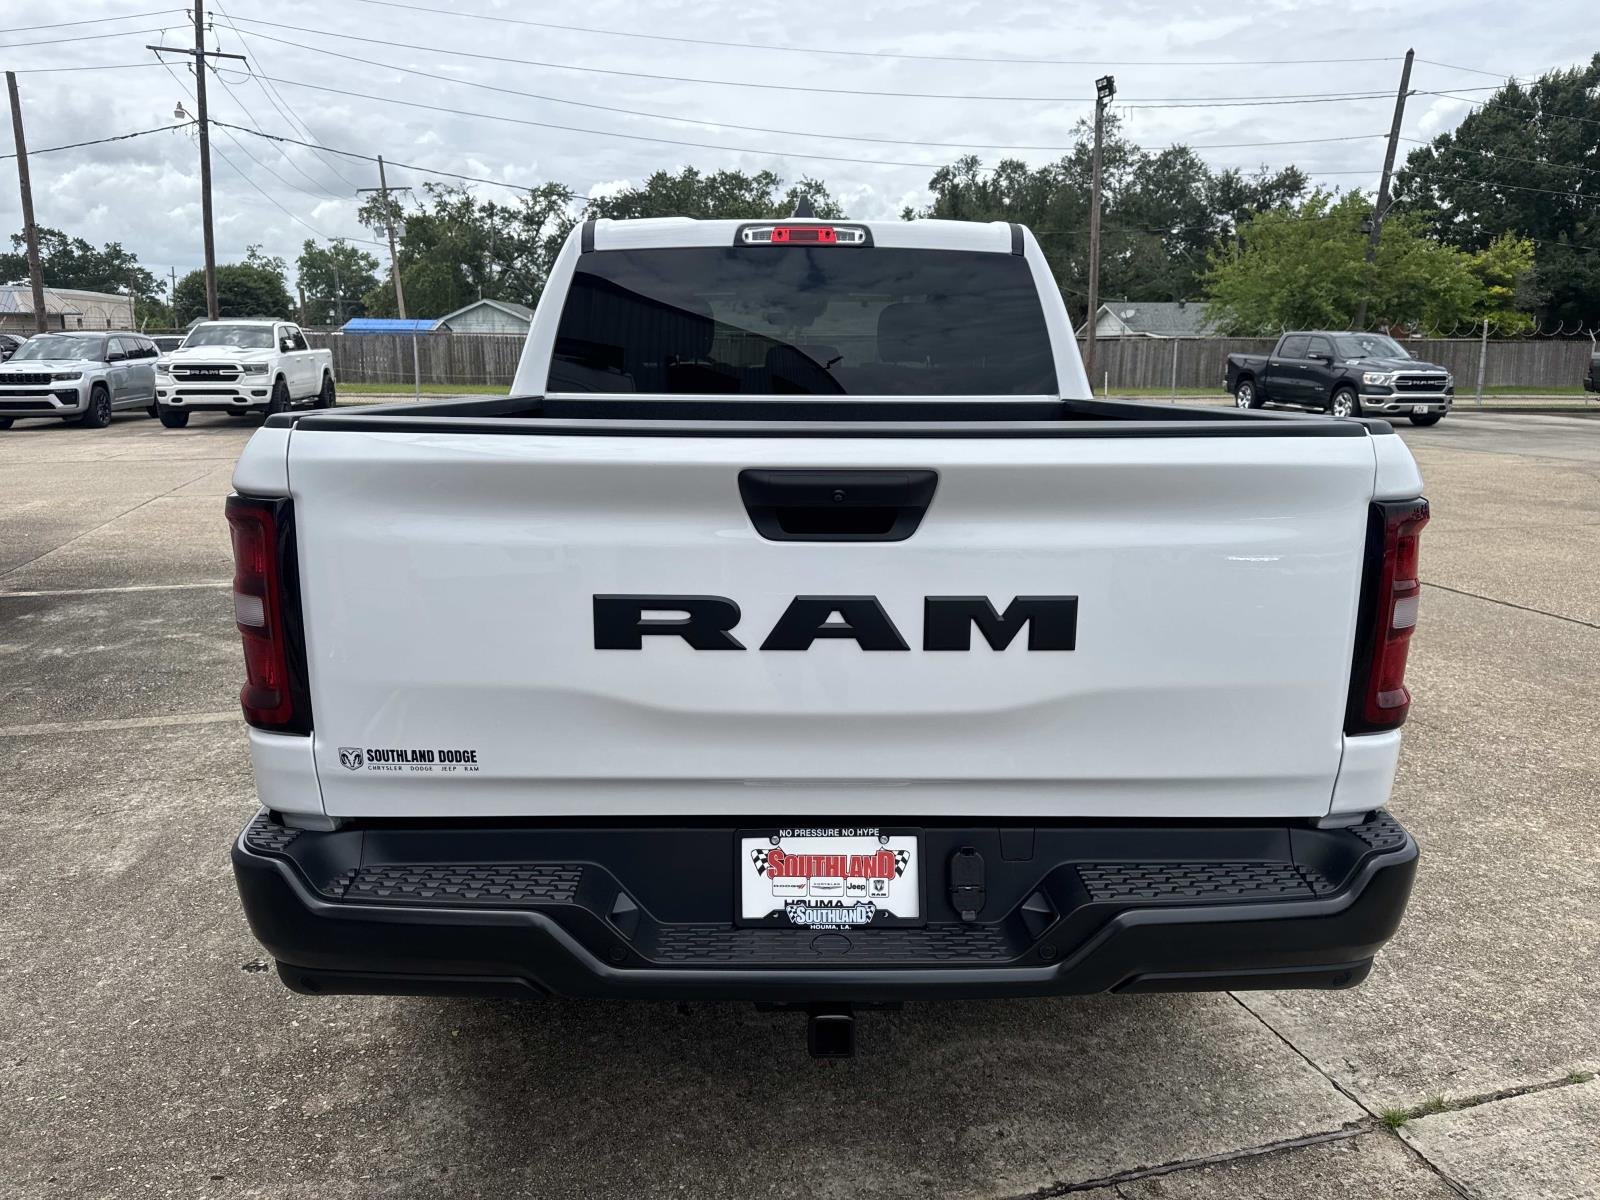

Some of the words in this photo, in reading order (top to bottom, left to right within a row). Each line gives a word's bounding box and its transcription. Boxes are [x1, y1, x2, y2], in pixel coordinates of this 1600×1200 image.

[592, 594, 1079, 651] RAM
[366, 749, 435, 763] SOUTHLAND
[438, 750, 478, 763] DODGE
[779, 829, 791, 837] NO
[794, 828, 840, 837] PRESSURE
[842, 828, 855, 836] NO
[857, 828, 880, 836] HYPE
[767, 849, 896, 880] SOUTHLAND
[846, 883, 866, 891] Jeep
[796, 906, 867, 924] SOUTHLAND
